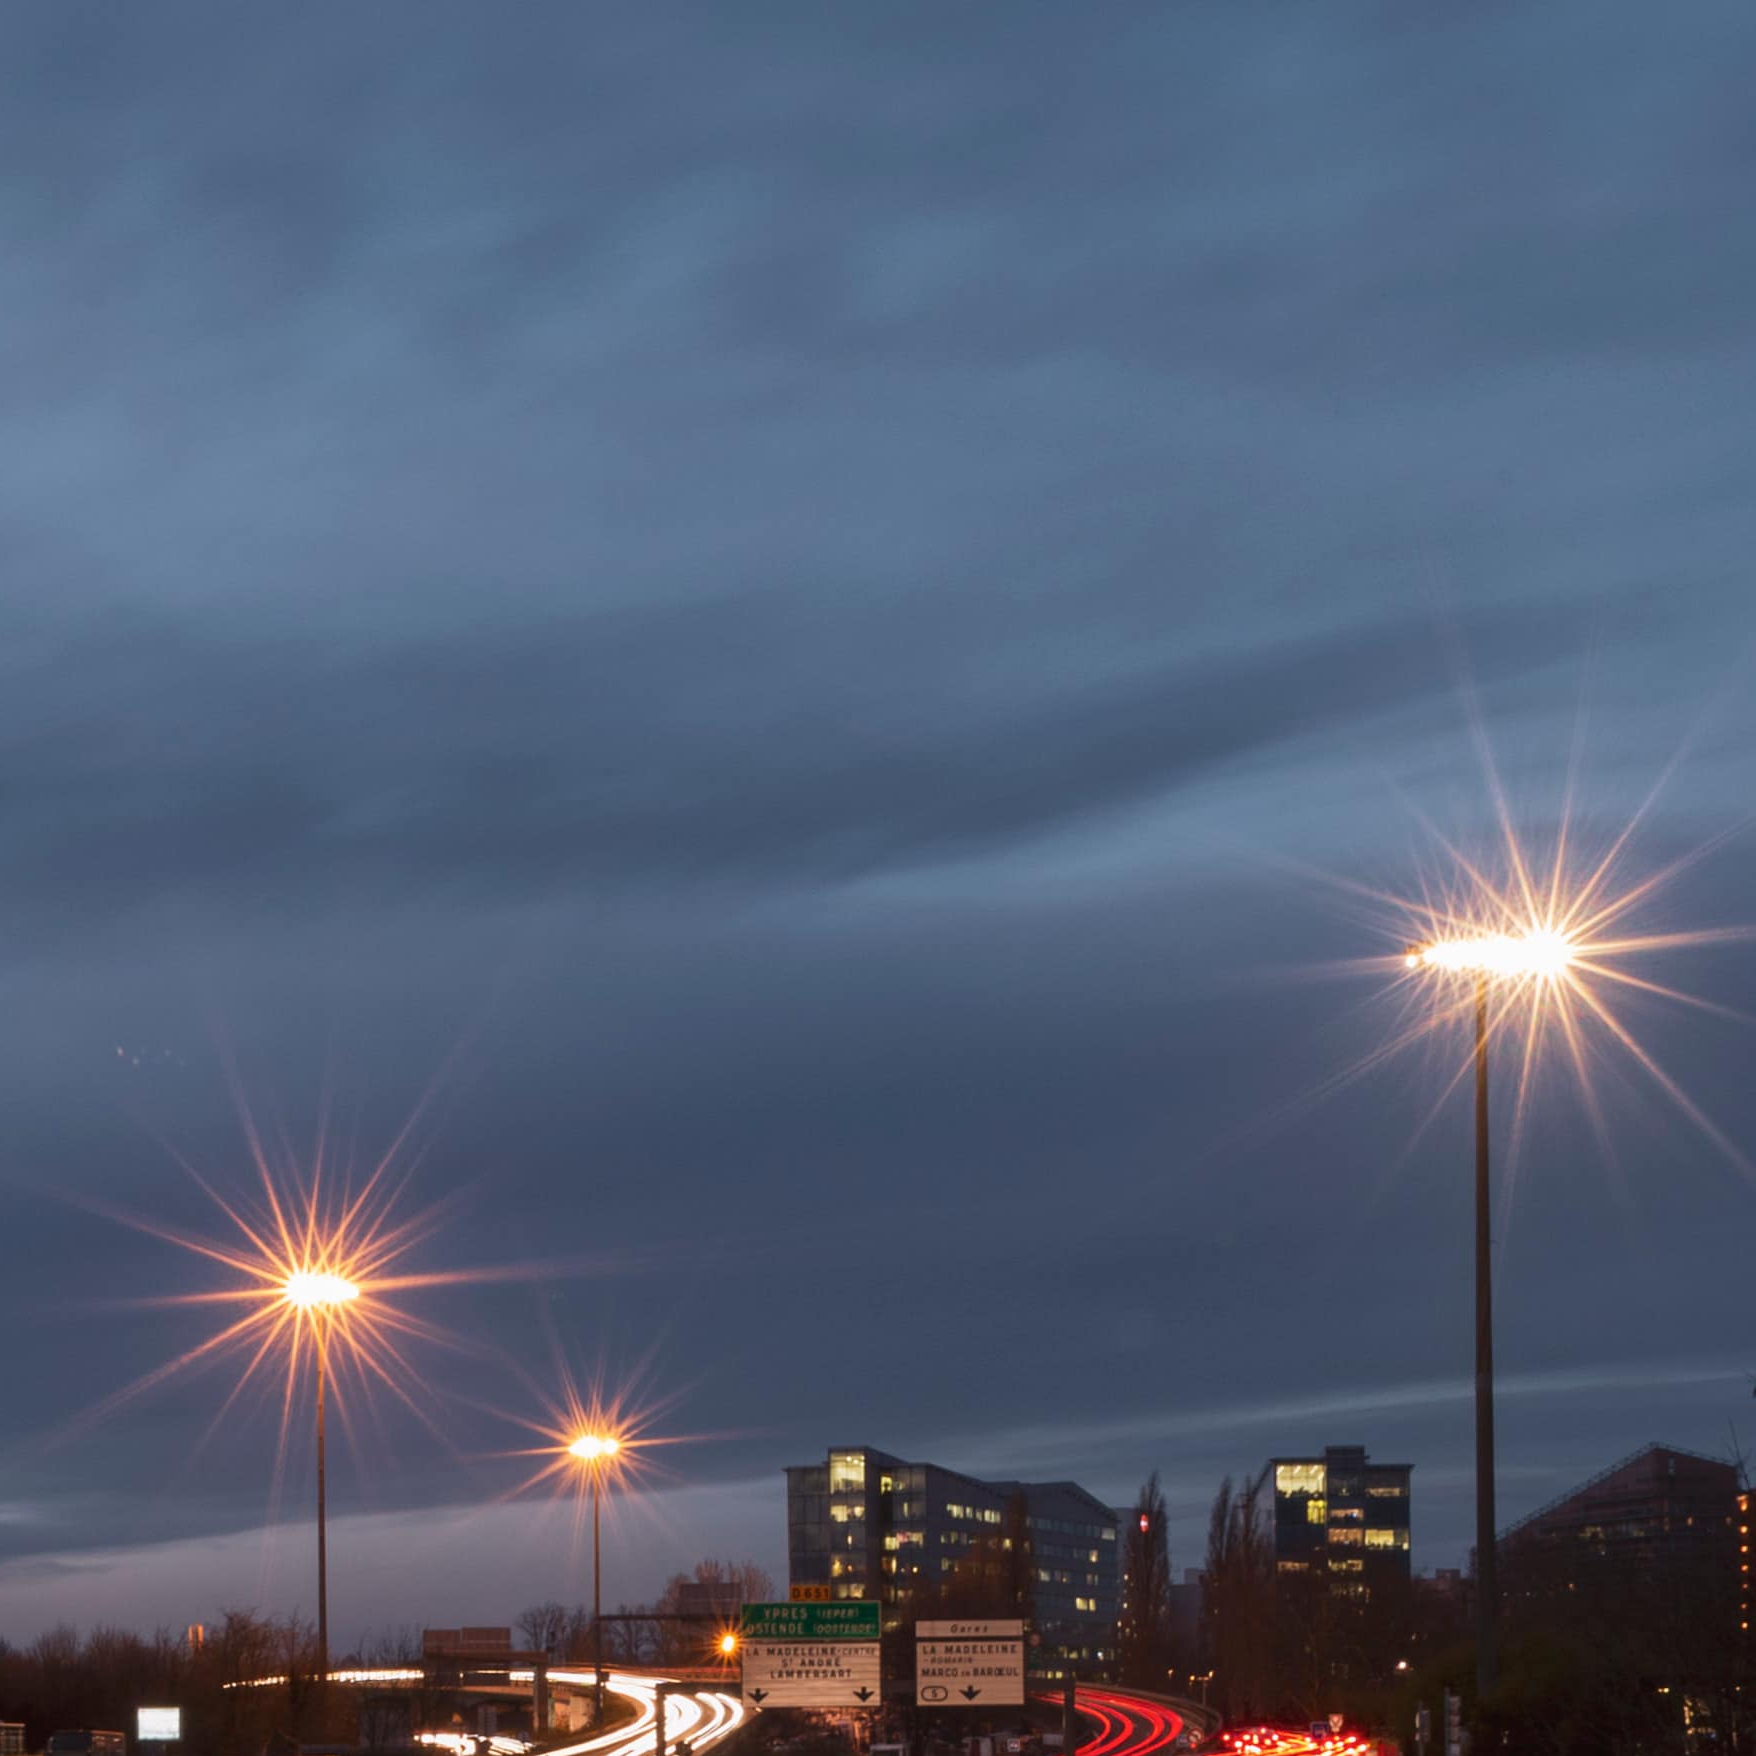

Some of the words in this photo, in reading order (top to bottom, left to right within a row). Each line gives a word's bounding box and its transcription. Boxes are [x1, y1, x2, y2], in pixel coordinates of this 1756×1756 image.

[792, 1587, 801, 1599] D
[804, 1587, 830, 1599] 651
[764, 1607, 808, 1620] YPRES
[747, 1622, 804, 1635] OSTENDE
[950, 1623, 988, 1634] Gares
[745, 1647, 759, 1657] LA
[922, 1645, 936, 1655] LA
[944, 1644, 1017, 1655] MADELEINE
[770, 1668, 852, 1679] LAMBERSART
